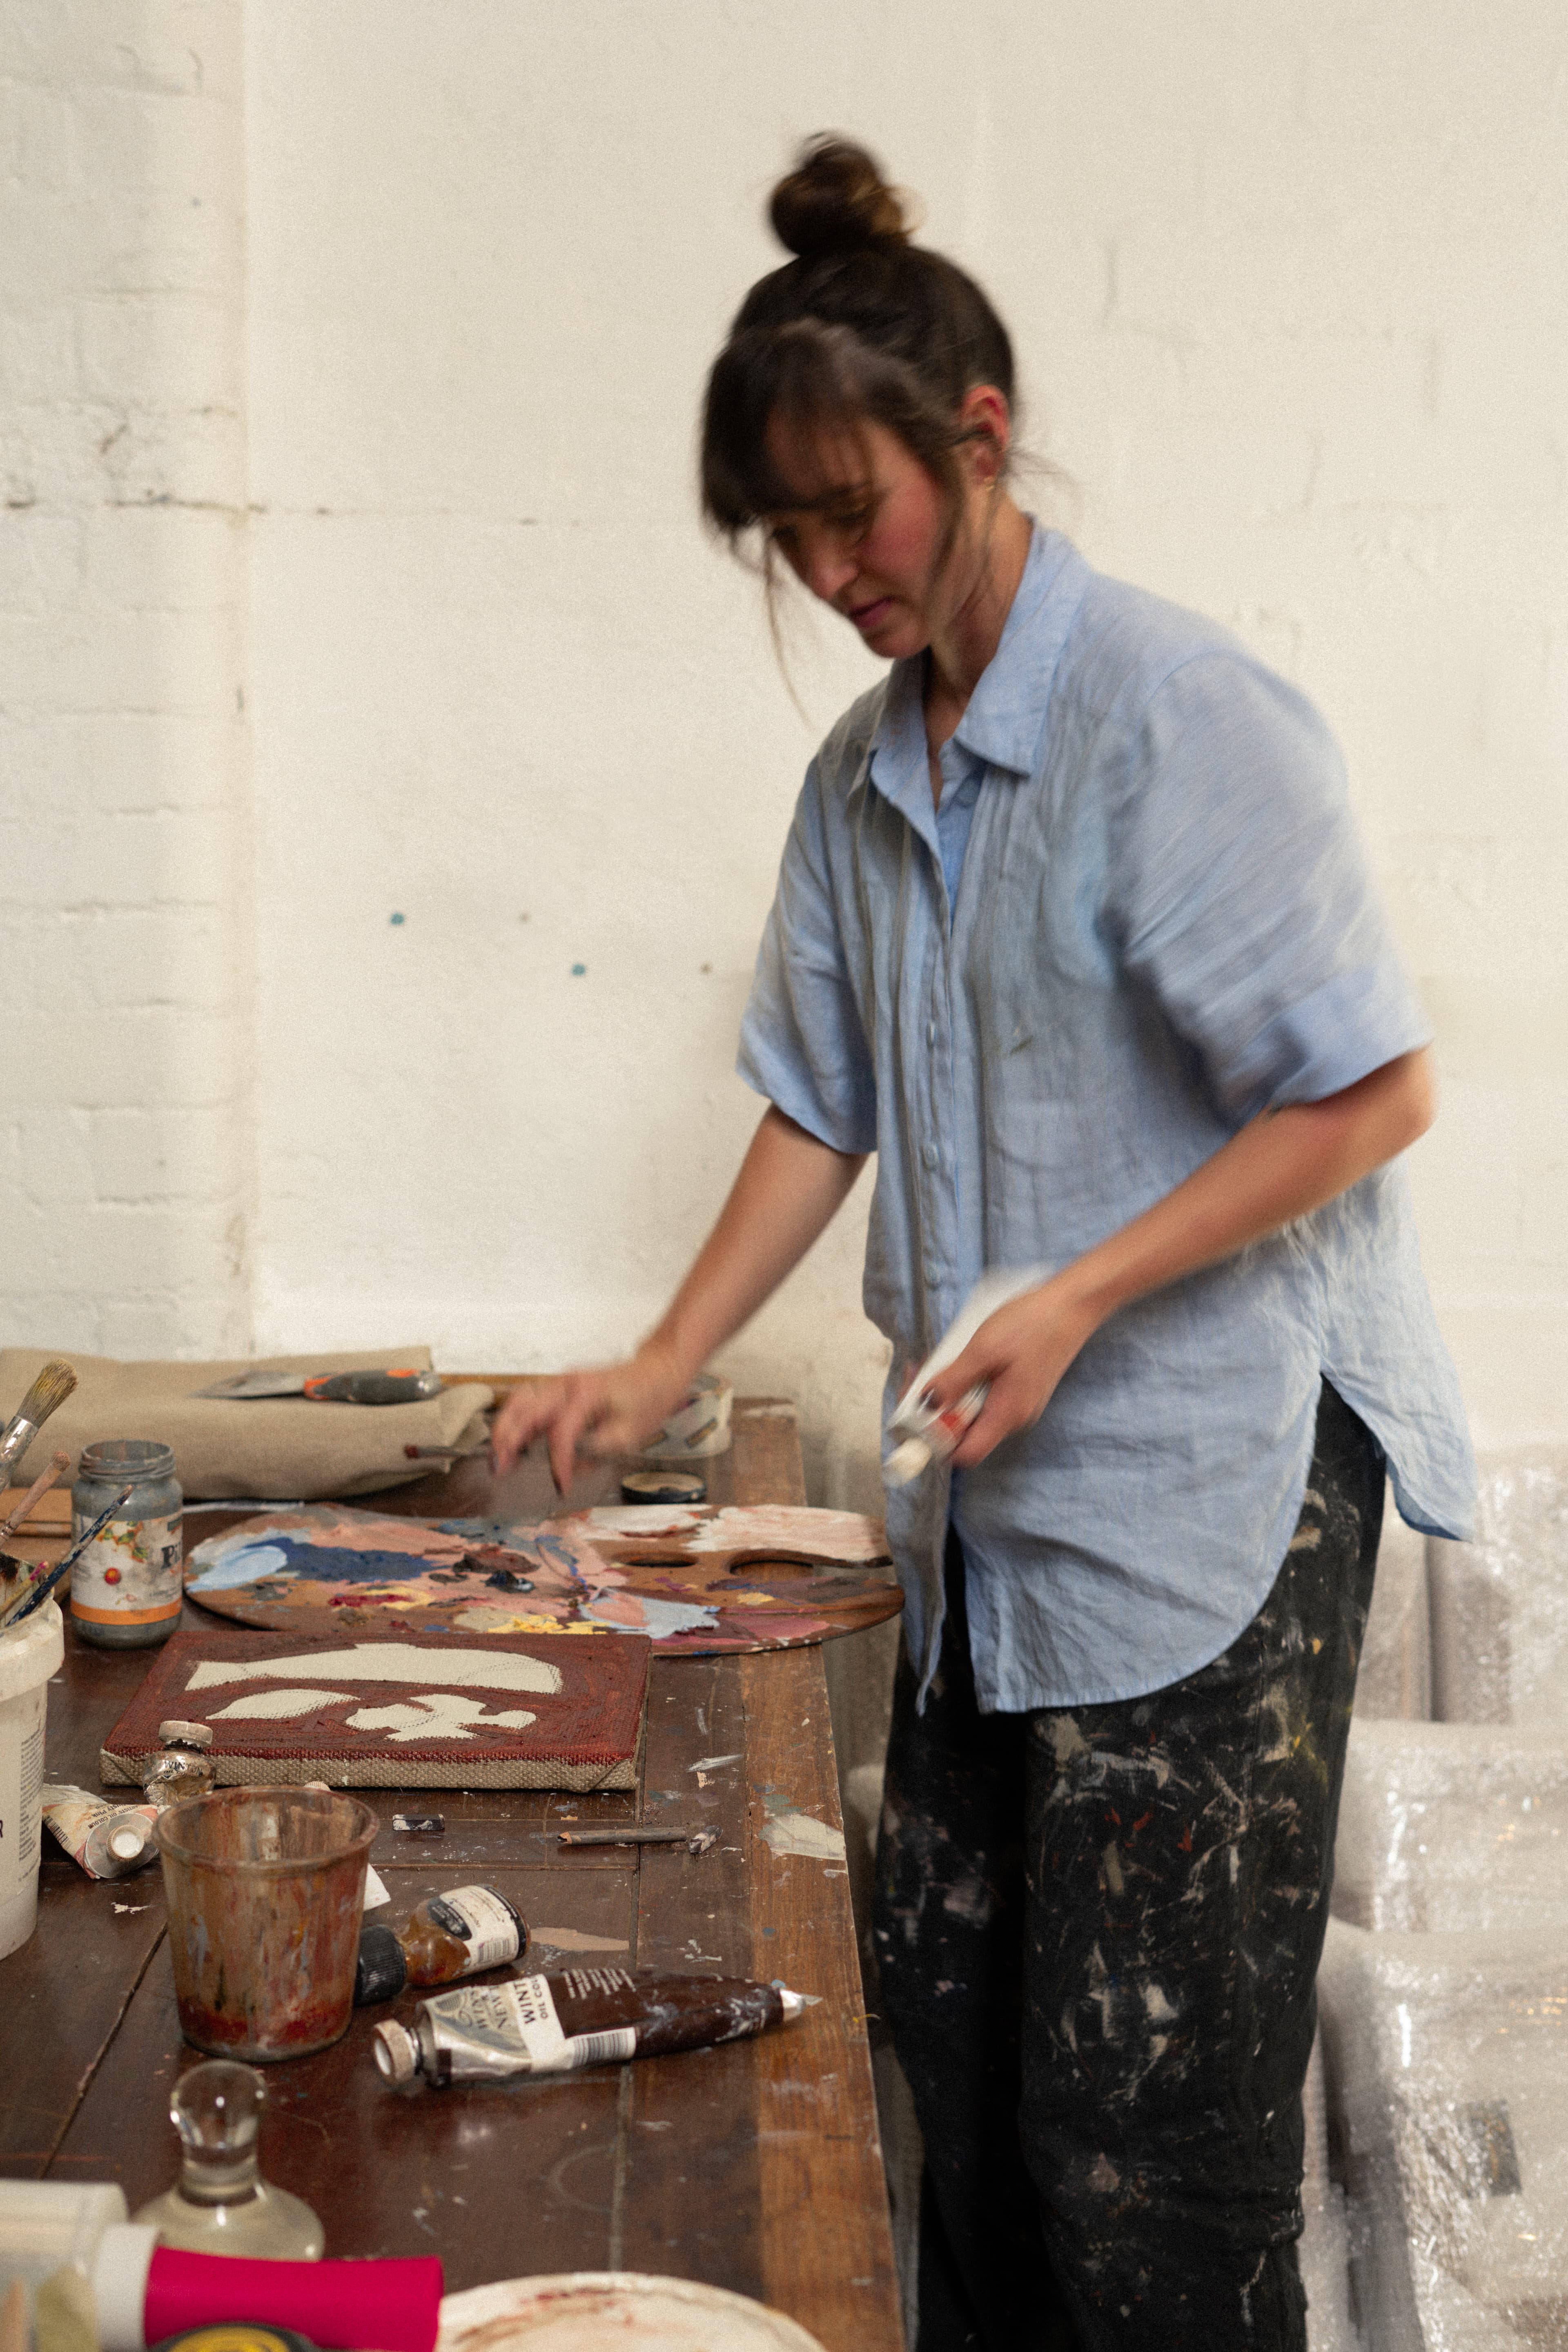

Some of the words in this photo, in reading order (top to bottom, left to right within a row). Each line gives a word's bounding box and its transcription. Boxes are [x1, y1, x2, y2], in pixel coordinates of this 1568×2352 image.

[88, 1816, 108, 1829] COLOUR
[513, 1983, 536, 2024] WINT
[538, 2002, 548, 2019] OIL
